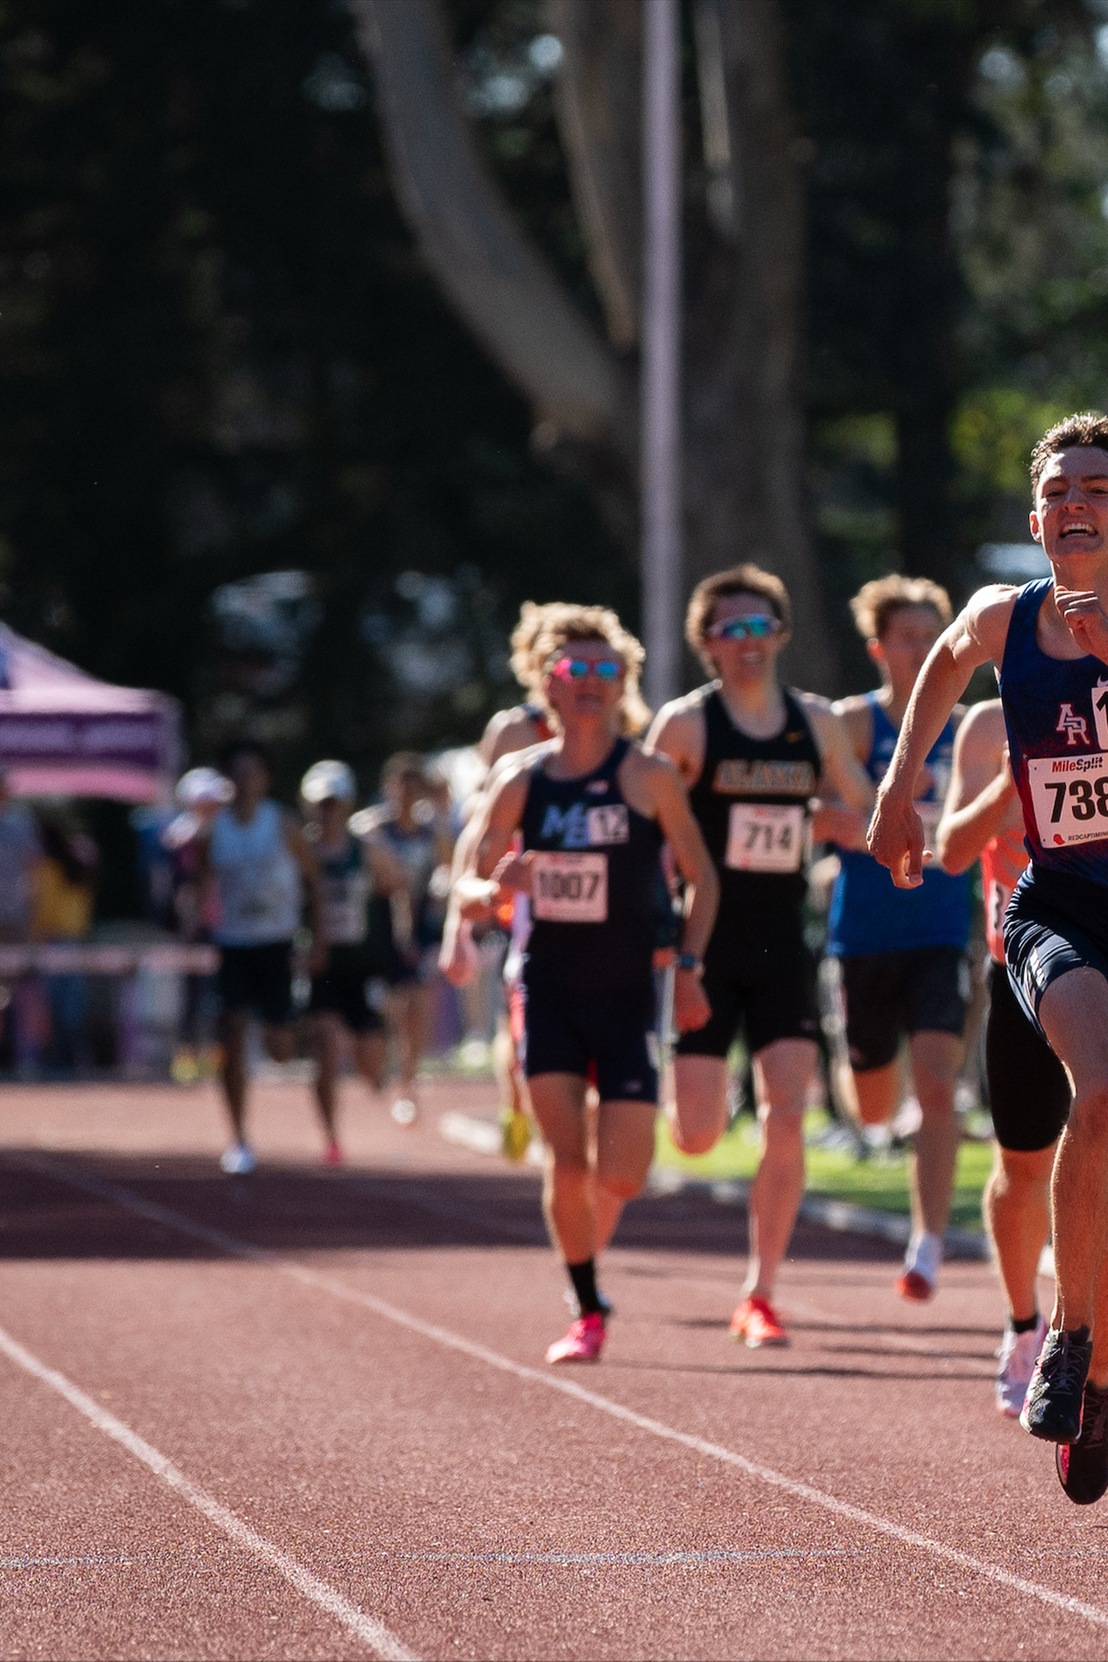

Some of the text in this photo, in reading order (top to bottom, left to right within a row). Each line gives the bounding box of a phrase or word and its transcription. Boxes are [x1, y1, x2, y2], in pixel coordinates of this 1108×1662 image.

[1056, 703, 1090, 745] AR
[1052, 757, 1103, 773] MileSplit
[744, 822, 792, 852] 714
[538, 869, 600, 900] 1007
